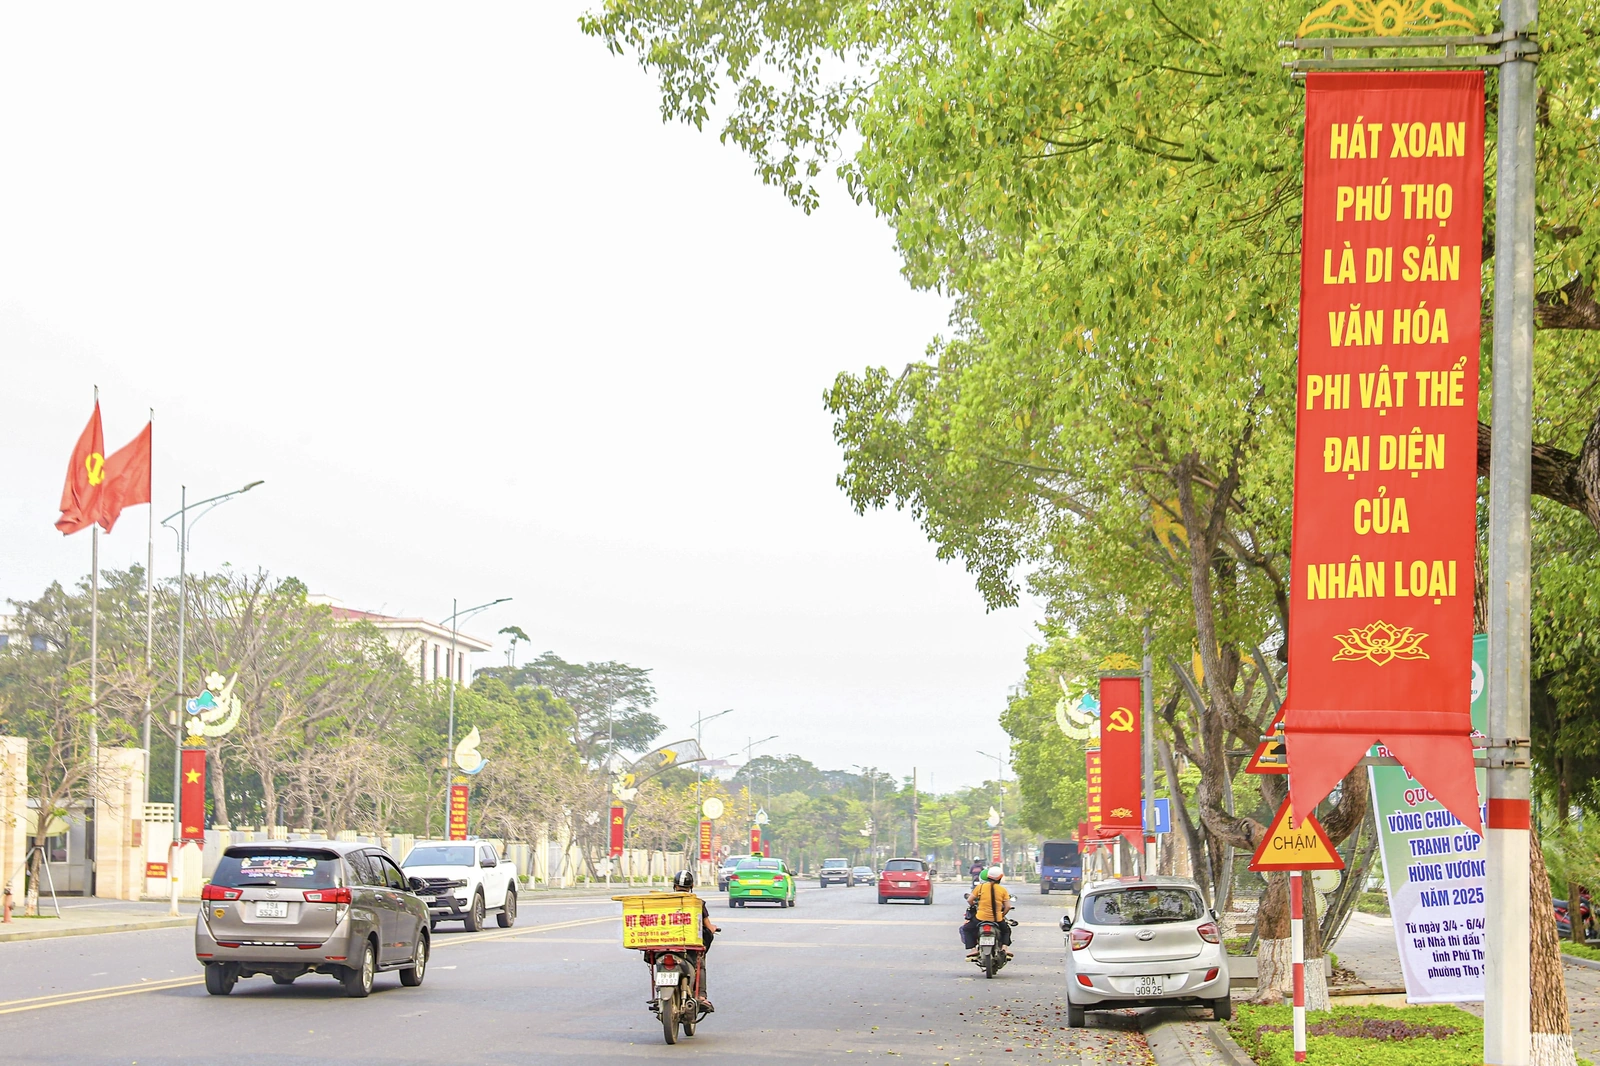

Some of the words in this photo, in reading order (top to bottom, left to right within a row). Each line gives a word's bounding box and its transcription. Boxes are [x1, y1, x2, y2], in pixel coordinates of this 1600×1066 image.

[1329, 116, 1383, 160] HÁT
[1390, 121, 1466, 159] XOAN
[1336, 177, 1393, 222] PHÚ
[1400, 182, 1453, 227] THỌ
[1323, 240, 1357, 285] LÀ
[1365, 246, 1393, 284] DI
[1401, 233, 1461, 282] SẢN
[1328, 302, 1384, 347] VĂN
[1392, 300, 1450, 345] HÓA
[1305, 373, 1351, 411] PHI
[1358, 364, 1409, 416] VẬT
[1415, 355, 1468, 407] THỂ
[1322, 435, 1370, 481] ĐẠI
[1378, 426, 1445, 479] DIỆN
[1353, 485, 1410, 535] CỦA
[1307, 554, 1386, 601] NHÂN
[1394, 560, 1457, 605] LOẠI
[1388, 811, 1422, 832] VÒNG
[1273, 834, 1317, 851] CHẬM
[1409, 836, 1451, 856] TRANH
[1454, 831, 1481, 852] CÚP
[1408, 862, 1442, 883] HÙNG
[1420, 887, 1450, 908] NĂM
[1452, 887, 1484, 905] 2025
[625, 914, 637, 930] VỊT
[639, 913, 658, 927] QUAY
[668, 909, 691, 925] TIẾNG
[1405, 922, 1417, 934] Từ
[1419, 921, 1440, 935] ngày
[1442, 919, 1458, 932] 3/4
[1413, 937, 1426, 951] tại
[1427, 935, 1446, 948] Nhà
[1448, 935, 1461, 947] thi
[1462, 931, 1480, 946] đấu
[1432, 949, 1451, 963] tỉnh
[1452, 949, 1471, 962] Phú
[1140, 976, 1157, 986] 30A
[1427, 965, 1462, 979] phường
[1462, 964, 1480, 979] Thọ
